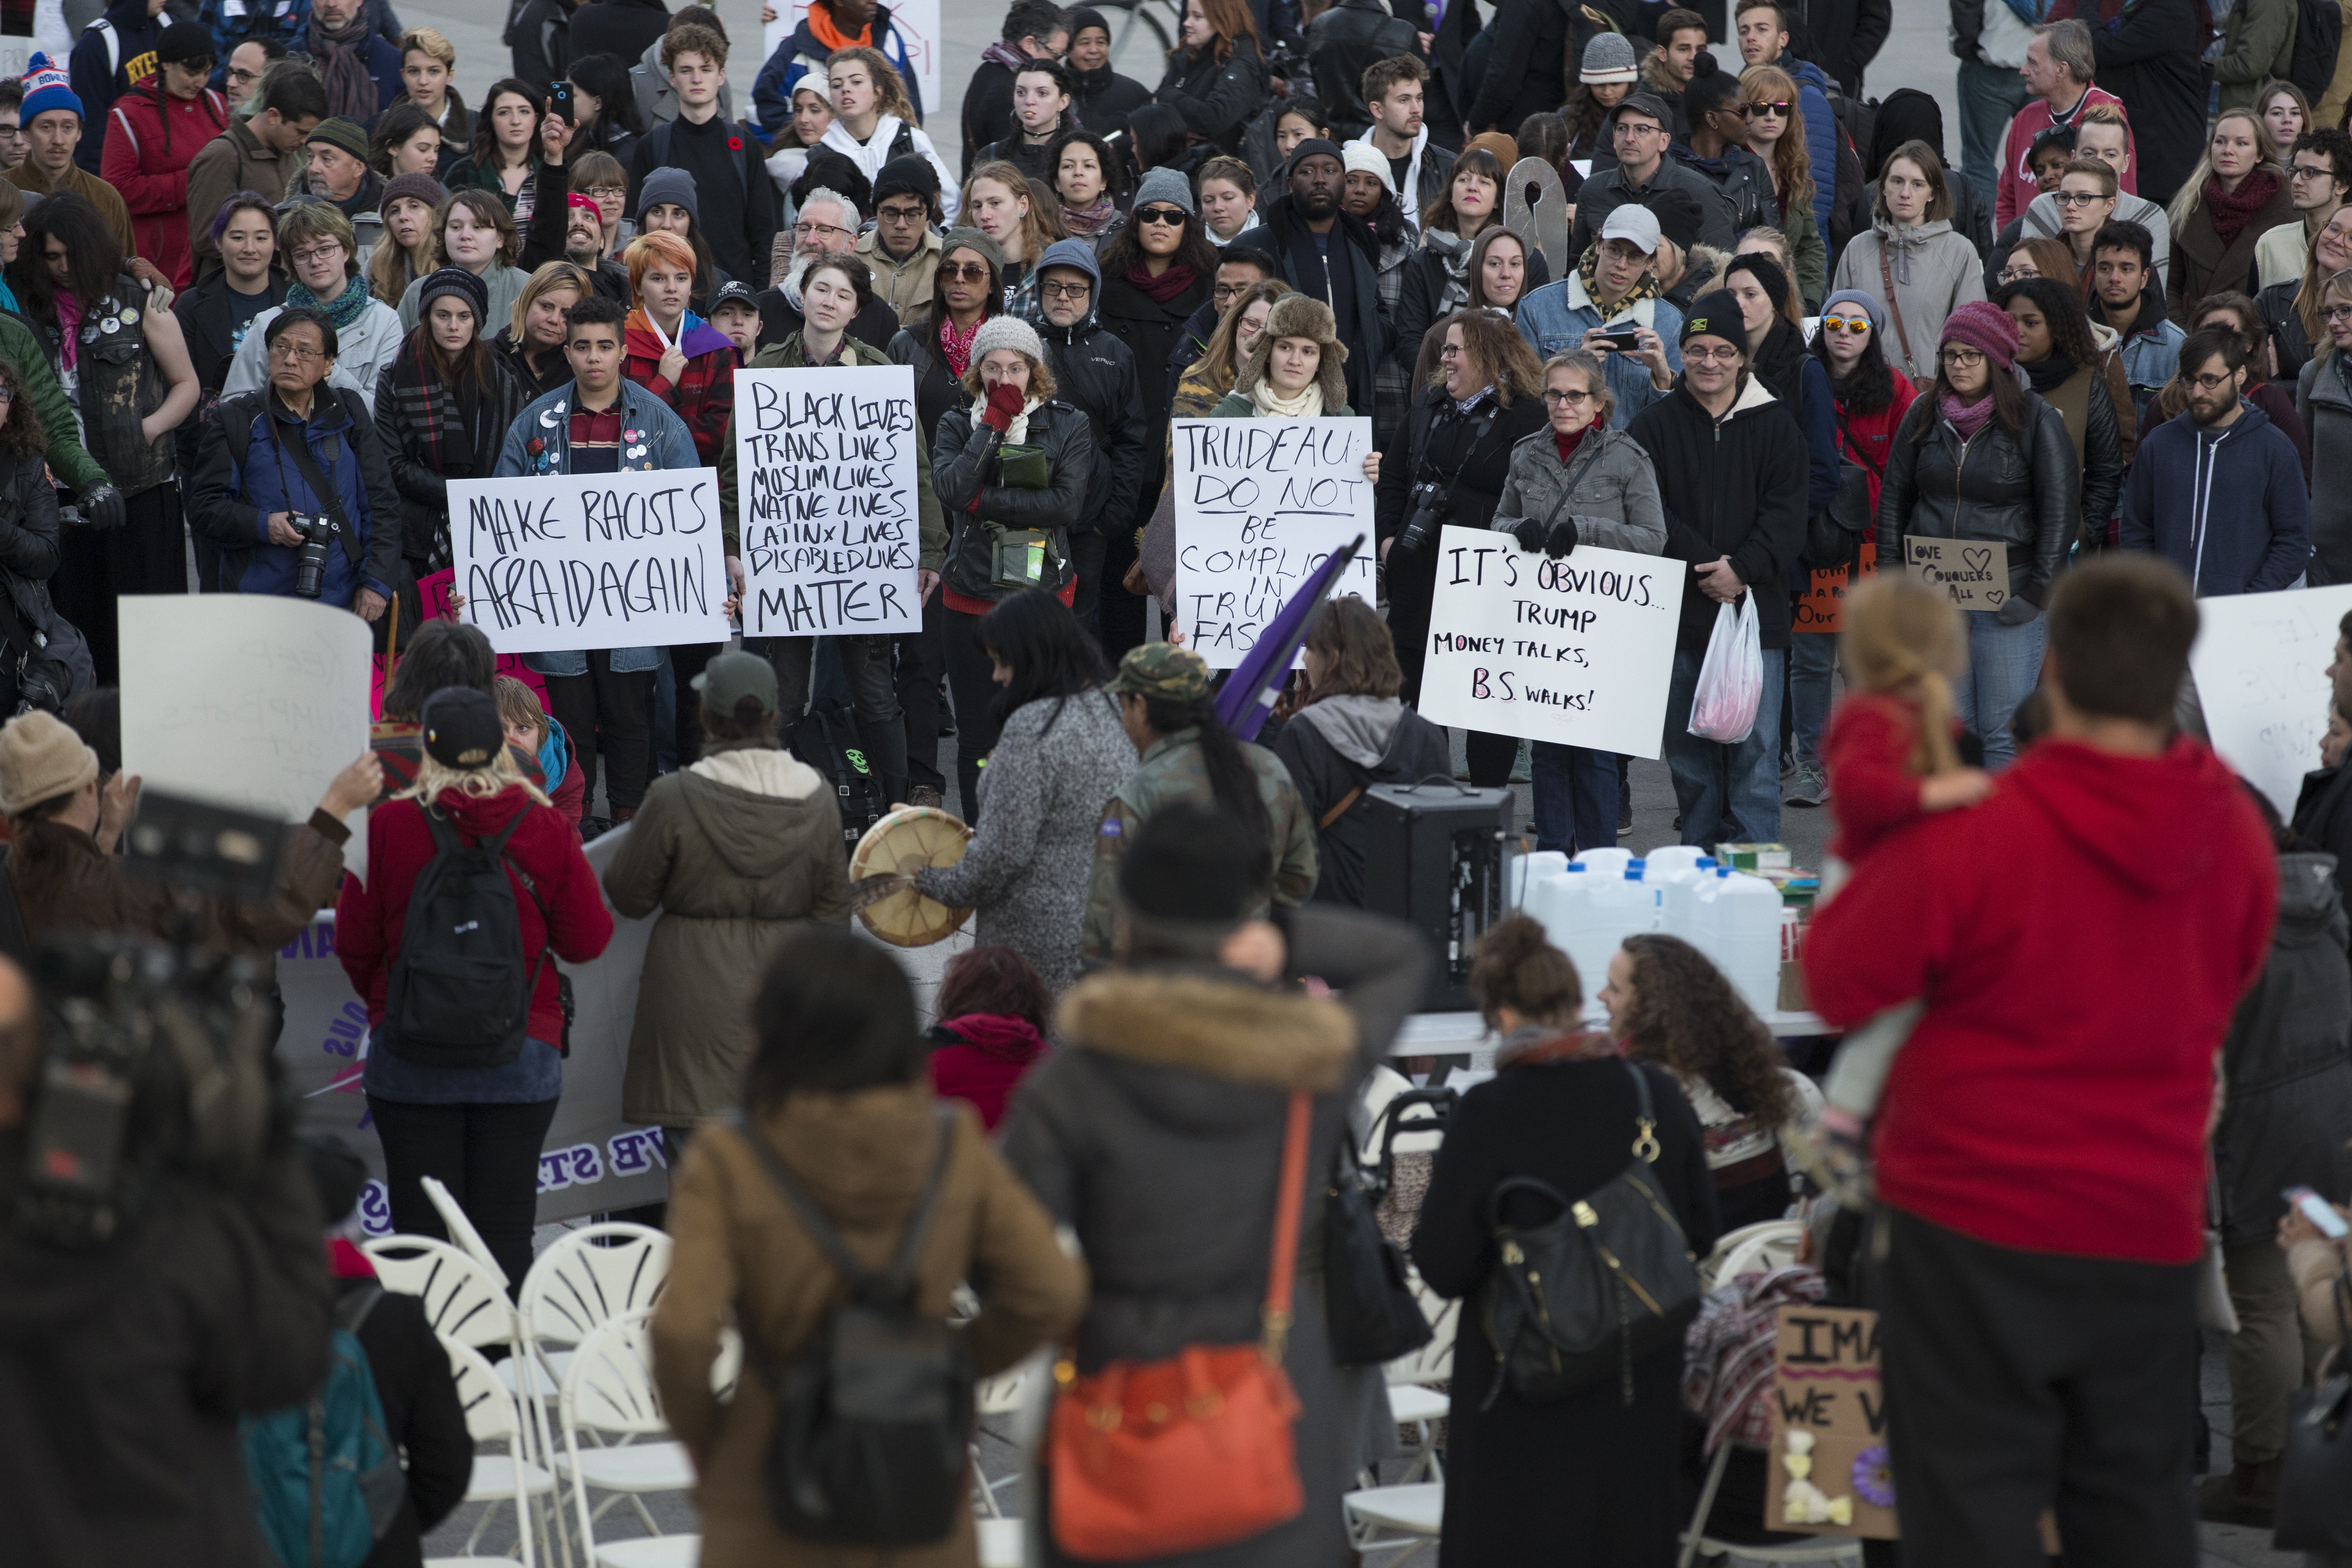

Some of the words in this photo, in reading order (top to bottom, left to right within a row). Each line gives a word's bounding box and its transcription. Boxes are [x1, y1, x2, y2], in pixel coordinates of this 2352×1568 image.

[752, 382, 846, 430] BLACK
[851, 396, 913, 432] LIVES
[1489, 406, 1499, 418] EOS
[745, 432, 829, 467] TRANS
[839, 432, 898, 462] LIVES
[833, 464, 896, 490] LIVES
[1194, 475, 1259, 508] DO
[1279, 476, 1363, 509] NOT
[470, 495, 567, 558] MAKE
[581, 482, 707, 542] RACISTS
[838, 490, 907, 518] LIVES
[843, 519, 913, 546] LIVES
[1242, 515, 1277, 544] BE
[750, 547, 864, 575] DISABLED
[866, 542, 914, 569] LIVES
[1181, 545, 1373, 578] COMPLICT
[1448, 544, 1519, 587] IT'S
[1906, 538, 1942, 566] LOVE
[1250, 576, 1282, 598] IN
[1948, 583, 1974, 604] ALL
[759, 579, 908, 632] MATTER
[1512, 600, 1597, 633] TRUMP
[1434, 632, 1504, 655] MONEY
[1513, 640, 1589, 669] TALKS,
[1472, 667, 1517, 701] B.S.
[1525, 684, 1595, 712] WALKS!
[1778, 1386, 1836, 1427] WE
